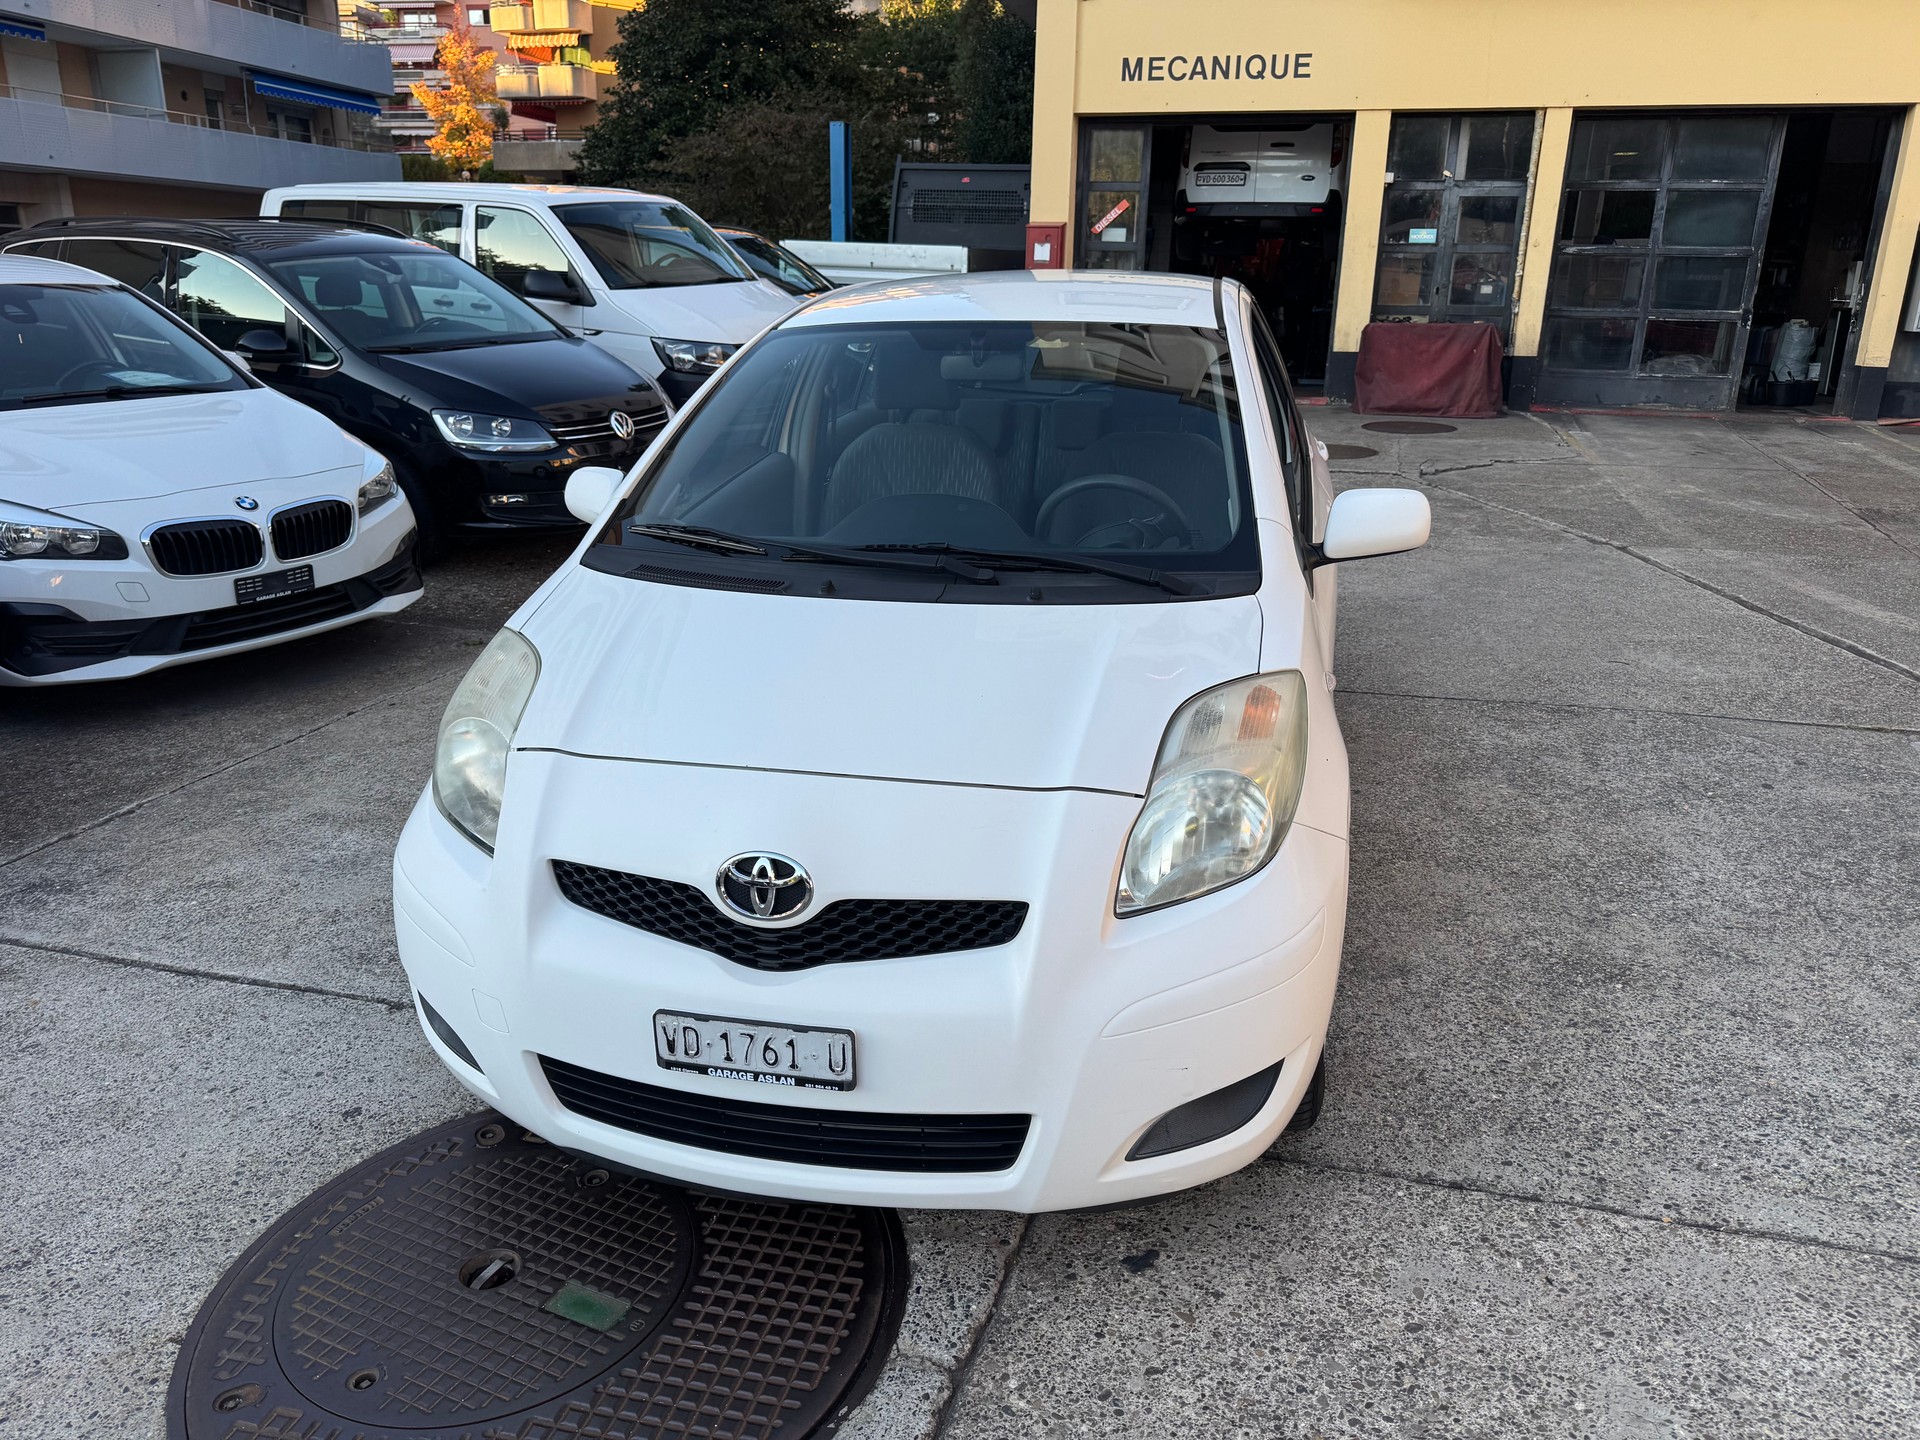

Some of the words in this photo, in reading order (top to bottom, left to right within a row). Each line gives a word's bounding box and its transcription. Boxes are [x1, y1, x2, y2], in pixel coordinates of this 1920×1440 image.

[1120, 52, 1314, 82] MECANIQUE
[1094, 207, 1123, 233] DIESEL
[255, 593, 276, 602] GARAGE
[660, 1019, 702, 1058] VD
[718, 1028, 802, 1072] 1761
[827, 1036, 848, 1076] U
[707, 1067, 755, 1081] GARAGE
[757, 1073, 796, 1086] ASLAN
